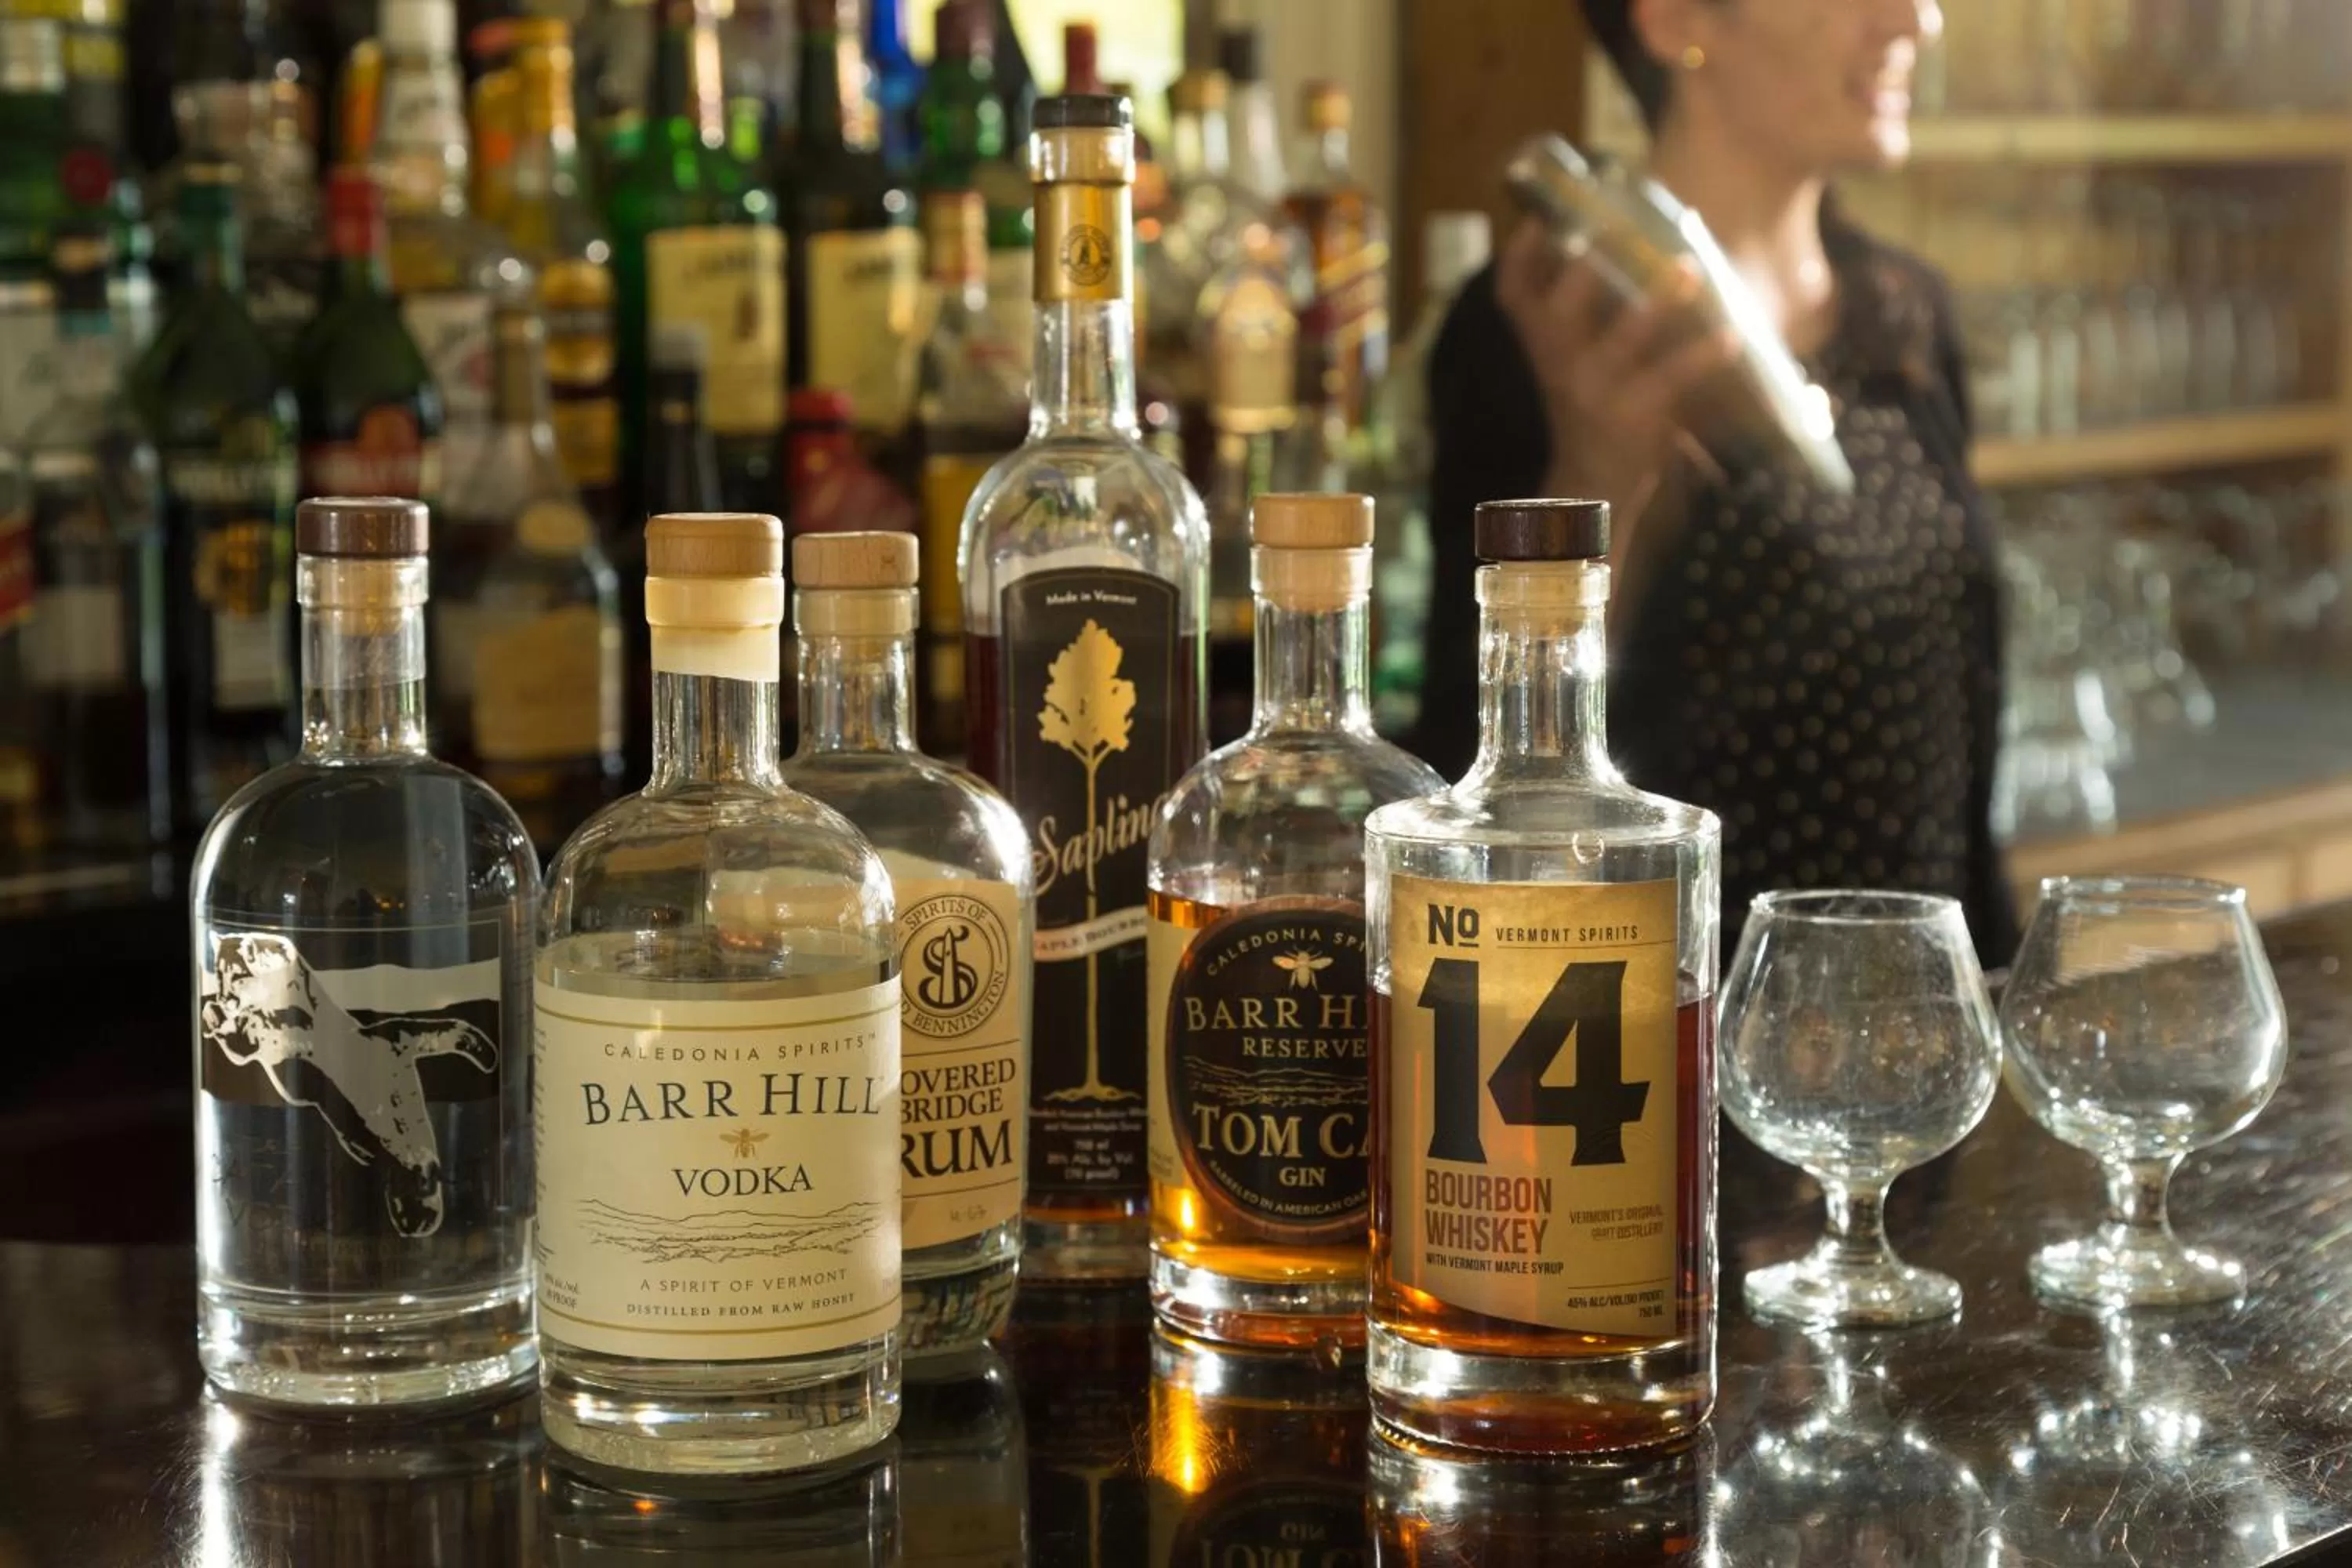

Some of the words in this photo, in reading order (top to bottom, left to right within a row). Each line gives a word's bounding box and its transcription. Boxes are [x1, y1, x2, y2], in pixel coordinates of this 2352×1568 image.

[905, 899, 966, 930] SPIRITS
[967, 904, 989, 921] OF
[1495, 927, 1570, 942] VERMONT
[1580, 924, 1639, 941] SPIRITS
[1207, 927, 1322, 976] CALEDONIA
[1334, 931, 1366, 953] SPI
[913, 970, 1004, 1034] BENNINGTON
[1184, 996, 1303, 1032] BARR
[1318, 994, 1367, 1029] H
[604, 1044, 760, 1062] CALEDONIA
[1242, 1036, 1367, 1058] RESERVE
[1417, 957, 1651, 1167] 14
[901, 1058, 1016, 1096] OVERED
[581, 1080, 739, 1126] BARR
[759, 1072, 880, 1116] HILL
[1192, 1101, 1303, 1158] TOM
[1319, 1112, 1369, 1159] C
[901, 1118, 1013, 1179] RUM
[672, 1163, 814, 1197] VODKA
[1279, 1166, 1327, 1188] GIN
[1425, 1168, 1552, 1214] BOURBON
[1274, 1201, 1342, 1215] AMERICAN
[1425, 1209, 1548, 1255] WHISKEY
[640, 1279, 651, 1291] A
[660, 1279, 720, 1293] SPIRIT
[730, 1279, 753, 1292] OF
[763, 1268, 848, 1290] VERMONT
[1425, 1252, 1446, 1266] WITH
[1449, 1255, 1492, 1272] VERMONT
[1495, 1260, 1529, 1275] MAPLE
[1531, 1261, 1564, 1276] SYRUP
[627, 1303, 710, 1316] DISTILLED
[719, 1305, 763, 1316] FROM
[772, 1301, 804, 1313] RAW
[811, 1293, 855, 1309] HONEY
